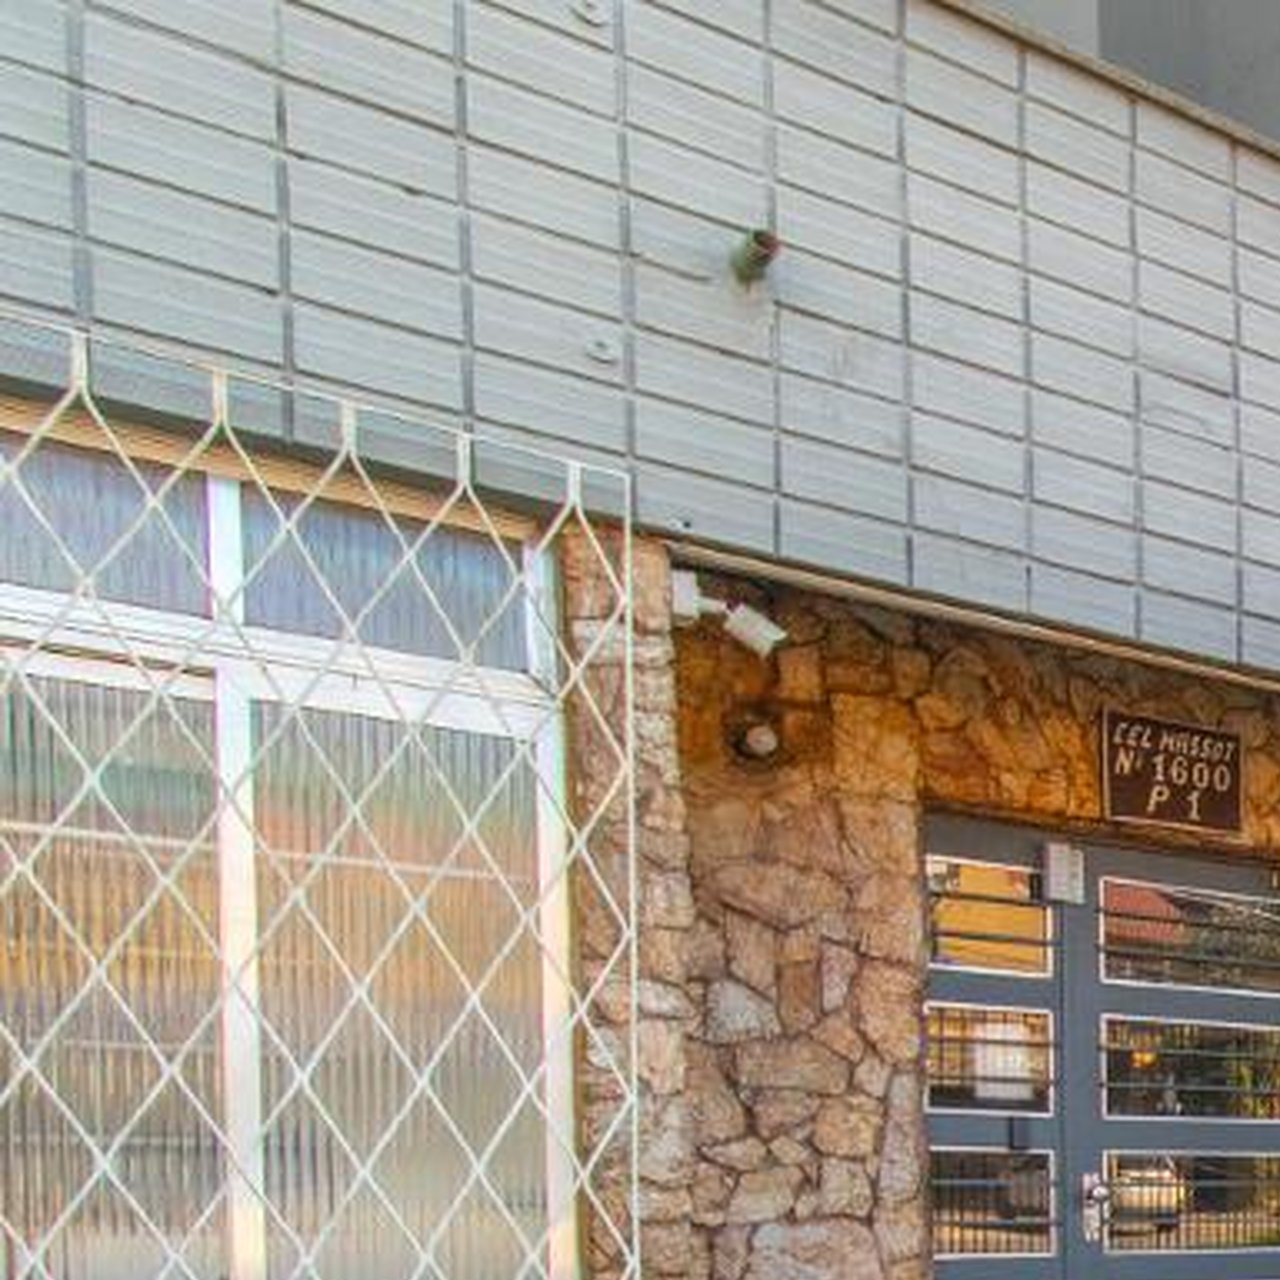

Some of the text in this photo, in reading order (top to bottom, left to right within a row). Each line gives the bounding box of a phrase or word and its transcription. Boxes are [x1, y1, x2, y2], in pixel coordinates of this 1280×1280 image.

[1152, 753, 1231, 791] 1600
[1147, 785, 1200, 820] P 1
